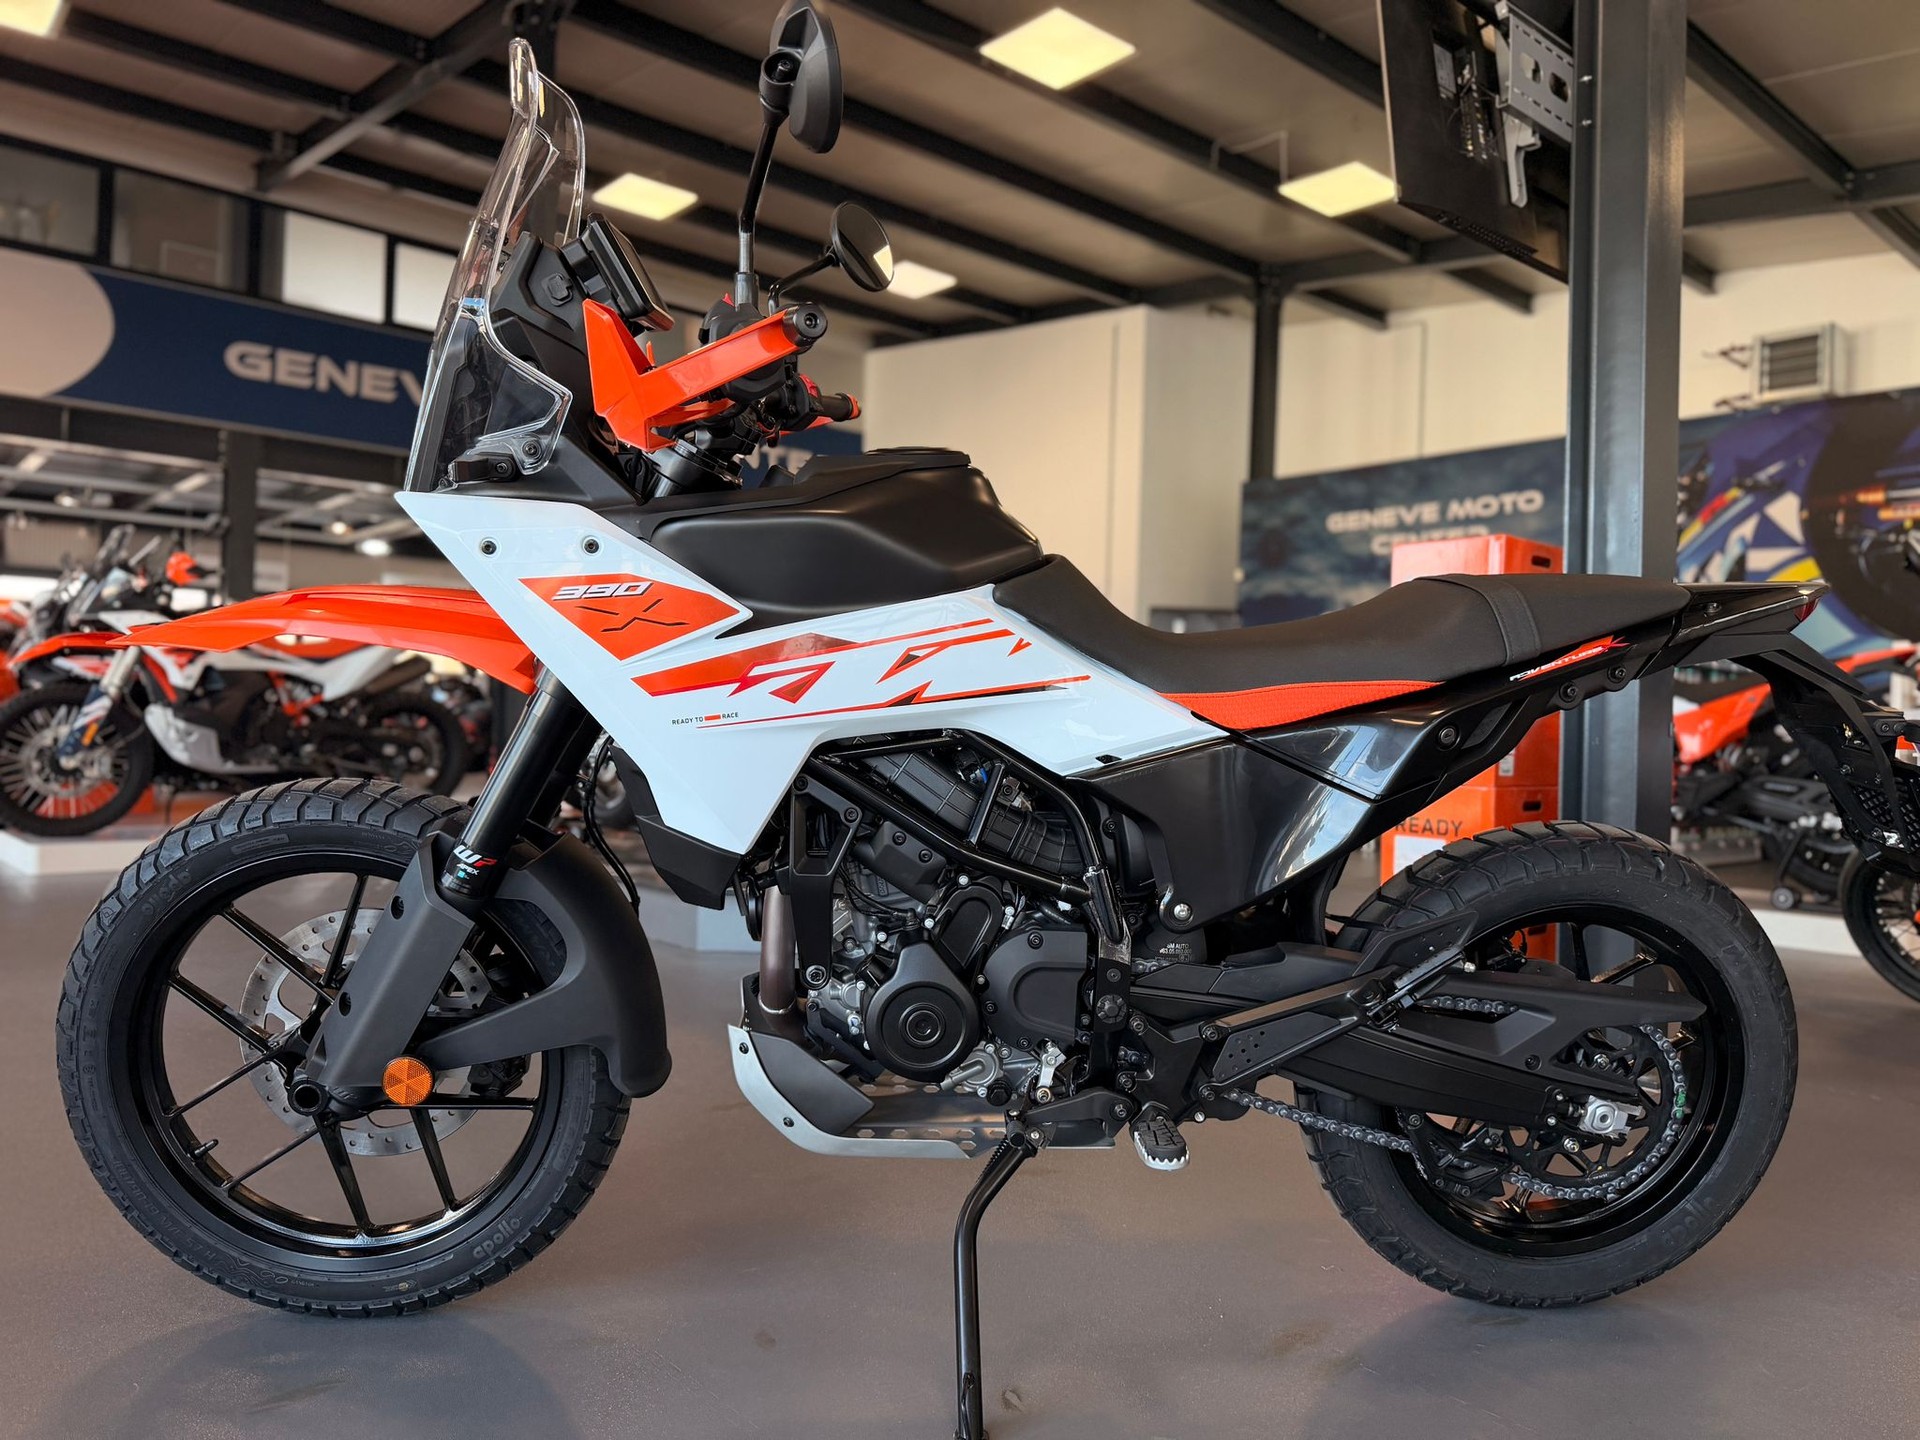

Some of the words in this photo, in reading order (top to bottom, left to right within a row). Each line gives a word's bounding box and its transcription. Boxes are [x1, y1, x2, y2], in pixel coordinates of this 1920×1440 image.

[1326, 501, 1440, 534] GENEVE
[1447, 489, 1545, 523] MOTO
[552, 581, 655, 601] 390
[671, 717, 694, 726] READY
[721, 711, 739, 719] RACE
[1394, 817, 1464, 837] READY
[456, 862, 480, 876] APEX
[472, 1215, 521, 1260] apollo
